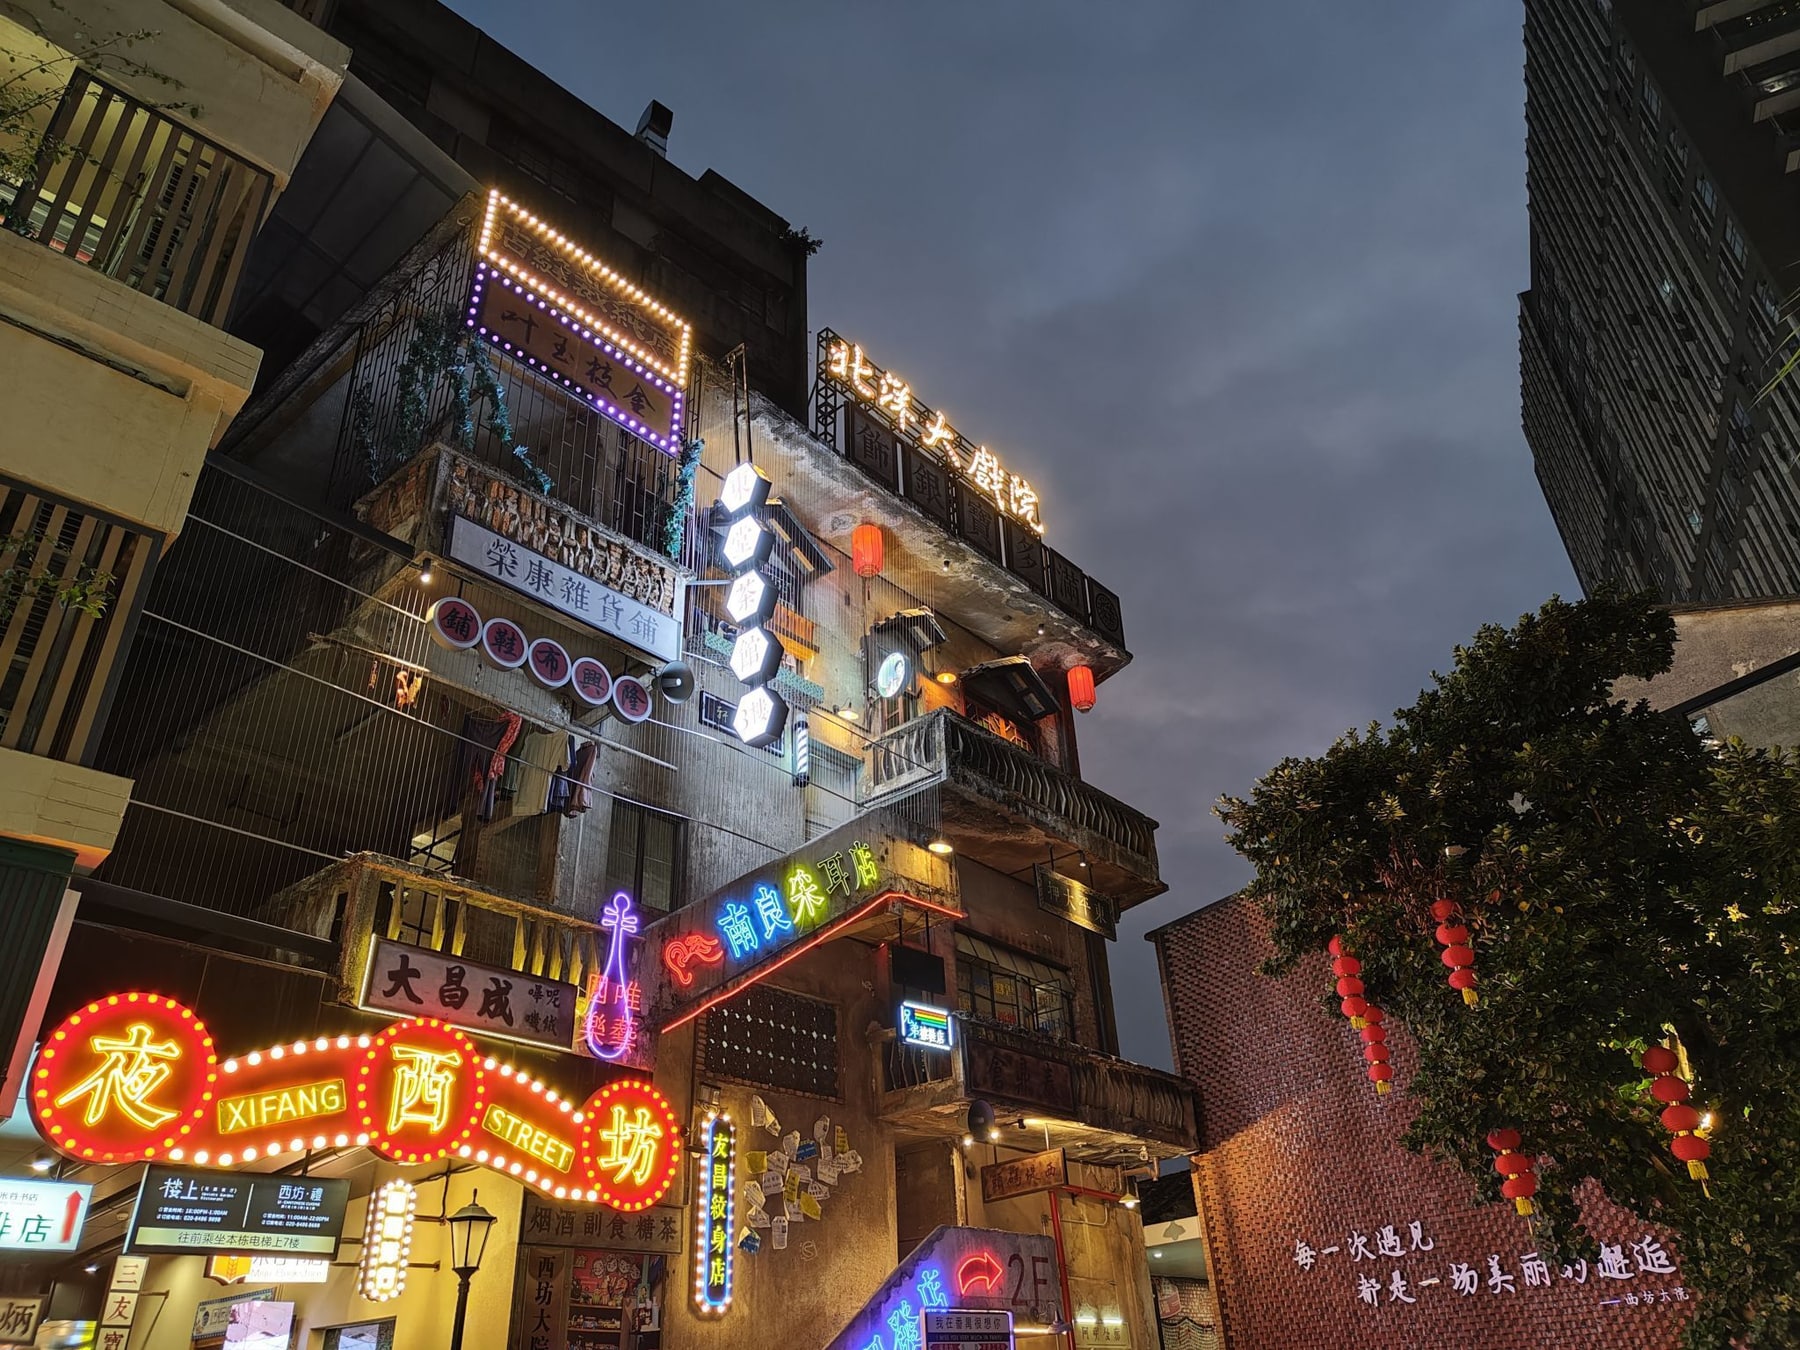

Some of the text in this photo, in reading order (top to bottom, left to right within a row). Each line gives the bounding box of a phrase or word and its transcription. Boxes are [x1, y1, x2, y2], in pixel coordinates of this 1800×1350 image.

[382, 953, 515, 1027] 大昌成
[55, 1023, 663, 1187] 夜 XIFANG 西 STREET 坊
[158, 1176, 199, 1200] 楼上
[1292, 1220, 1435, 1271] 每一次遇见
[1008, 1253, 1050, 1307] 2F
